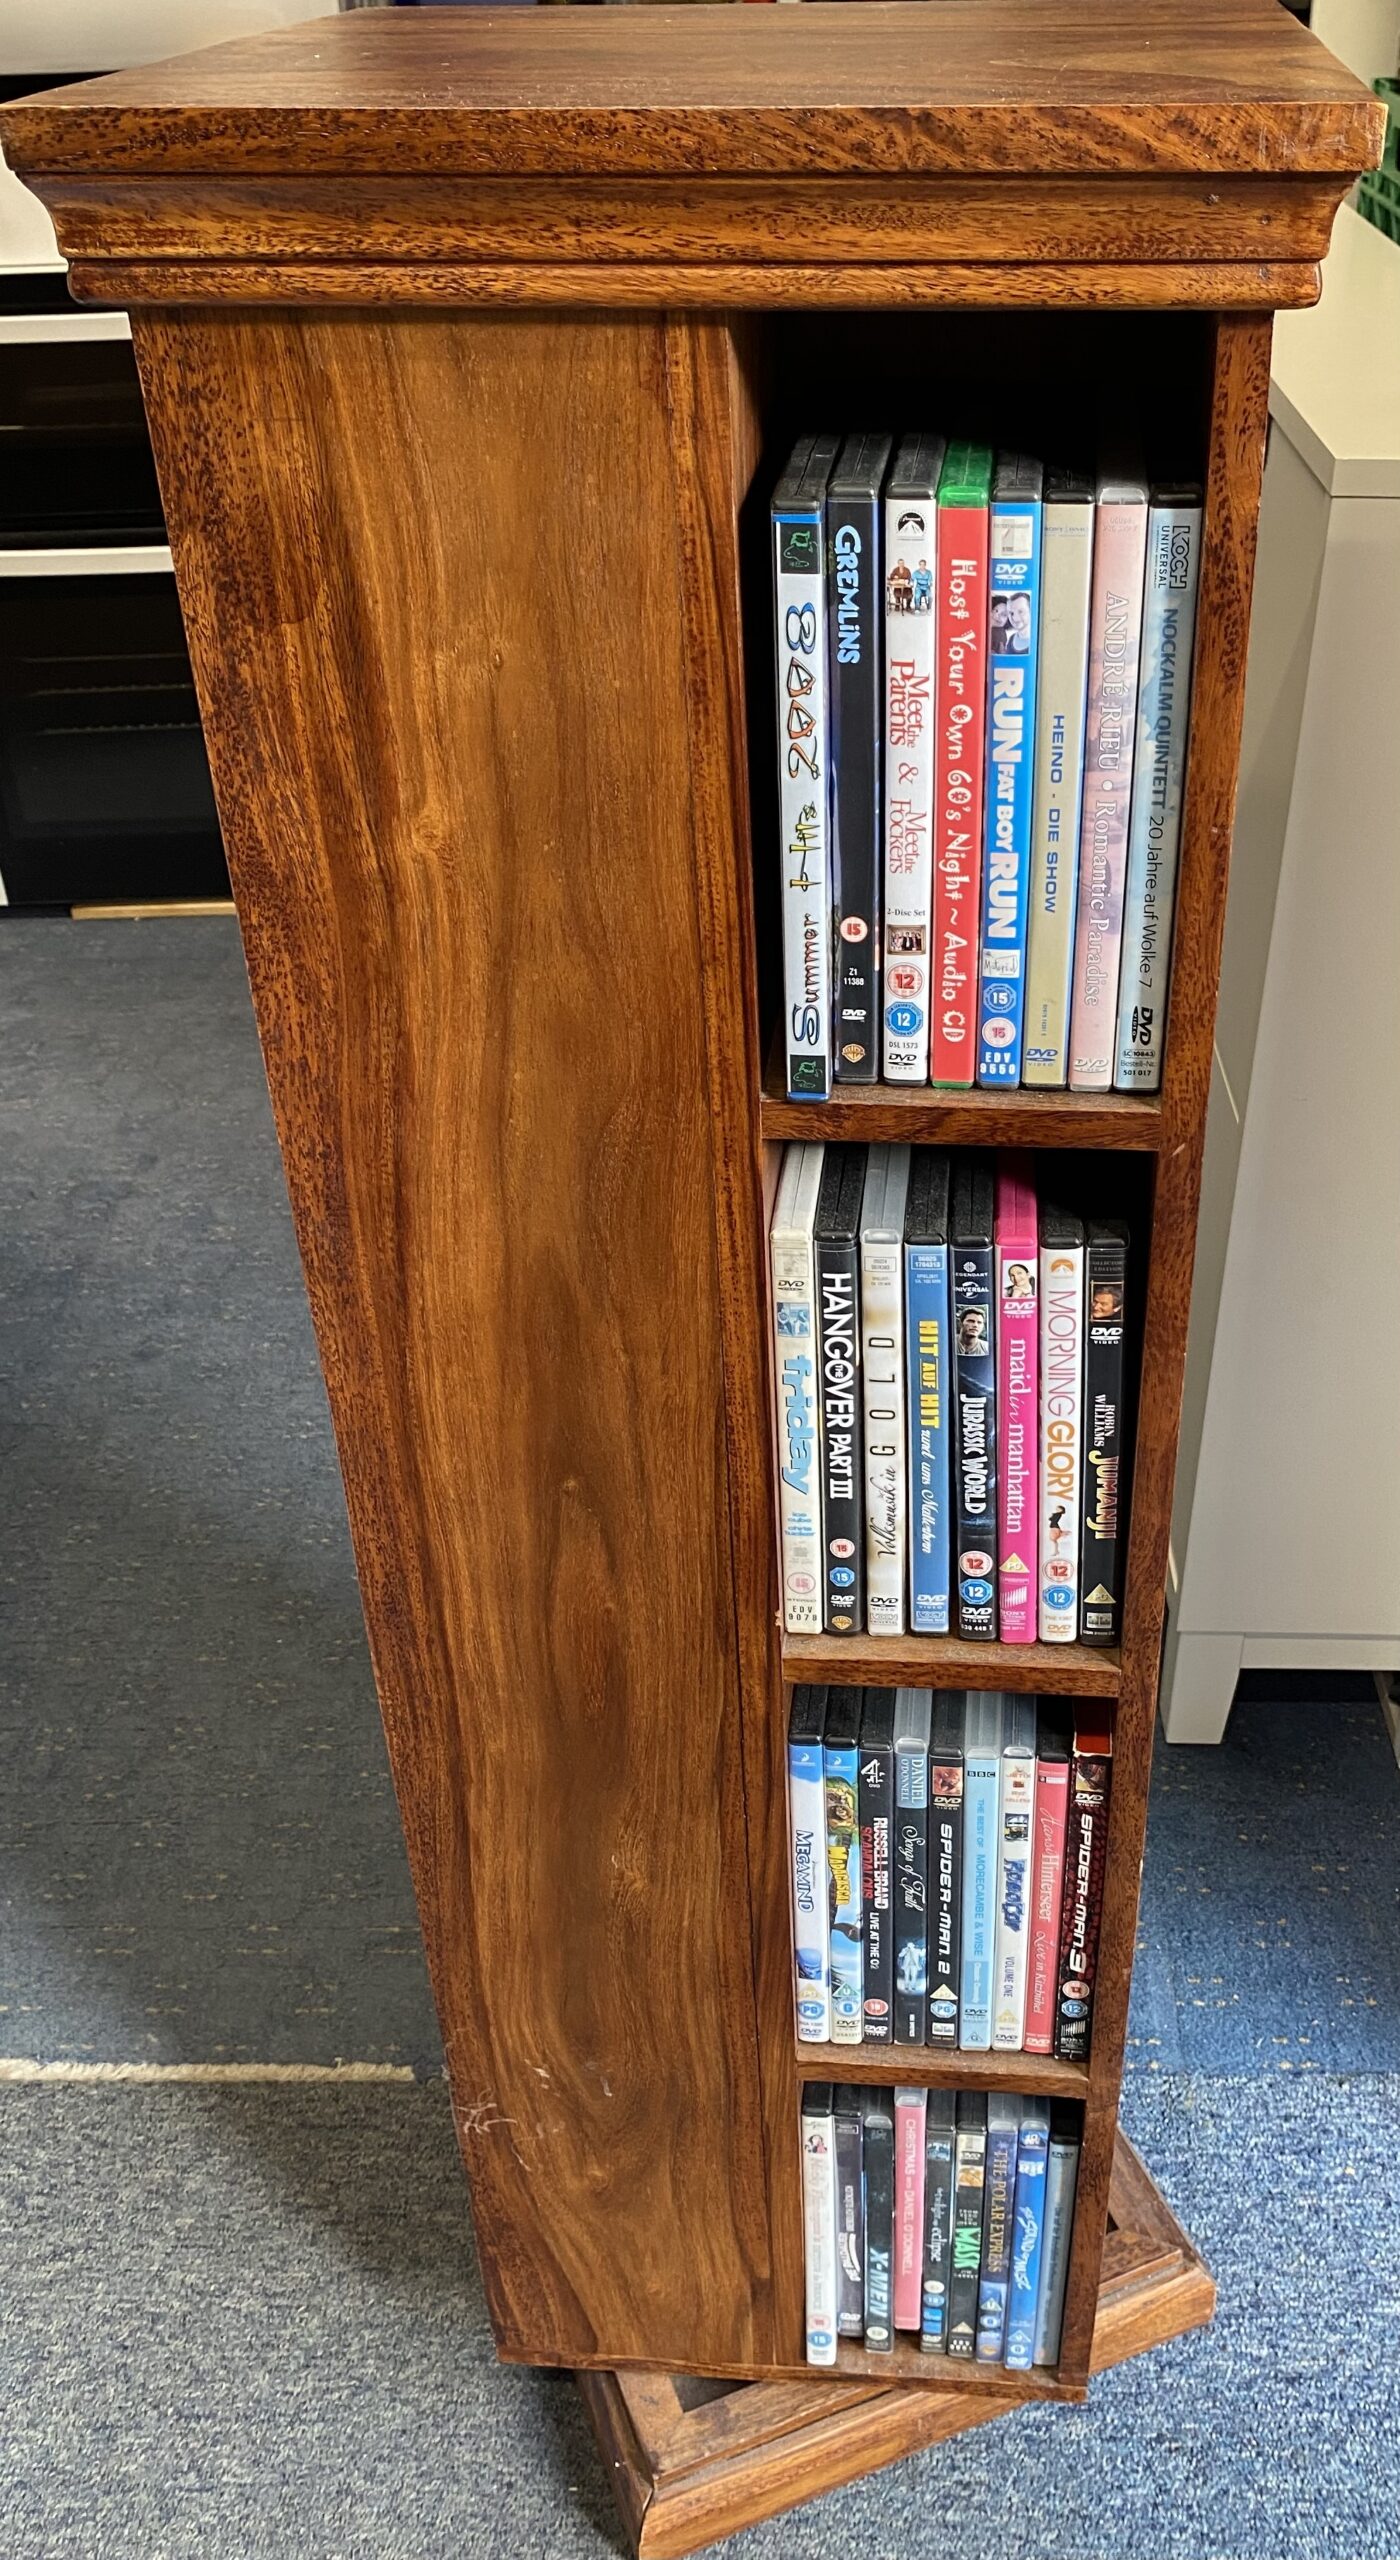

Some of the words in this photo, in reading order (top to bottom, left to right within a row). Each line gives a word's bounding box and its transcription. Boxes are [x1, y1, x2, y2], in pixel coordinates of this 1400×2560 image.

[1158, 526, 1169, 589] UNIVERSAL
[1169, 525, 1191, 590] KOCH
[949, 559, 978, 620] Host
[948, 629, 977, 697] Your
[1103, 592, 1129, 697] ANDRÉ
[1159, 608, 1179, 711] NOCKALM
[786, 602, 821, 780] 2008
[889, 657, 915, 747] Parents
[906, 673, 930, 732] Meet
[946, 703, 974, 760] Own
[992, 667, 1024, 763] RUN
[906, 730, 919, 748] the
[1051, 714, 1064, 784] HEINO
[1098, 702, 1122, 771] RIEU
[898, 762, 919, 784] &
[1152, 716, 1173, 809] QUINTETT
[946, 769, 972, 822] 60's
[997, 764, 1017, 803] FAT
[904, 812, 927, 860] Meet
[996, 805, 1015, 853] BOY
[1047, 808, 1060, 843] DIE
[1148, 816, 1165, 839] 20
[904, 858, 917, 874] the
[939, 829, 973, 901] Night
[1089, 800, 1116, 911] Romantic
[1144, 841, 1163, 891] Jahre
[988, 852, 1019, 939] RUN
[1044, 852, 1058, 913] SHOW
[887, 907, 912, 917] 2-Disc
[914, 908, 926, 917] Set
[1143, 893, 1159, 921] auf
[846, 923, 861, 936] 15
[1139, 921, 1157, 974] Wolke
[792, 912, 820, 1046] Summer
[895, 973, 915, 989] 12
[941, 931, 968, 1002] Audio
[1083, 918, 1110, 1007] Paradise
[992, 992, 1008, 1005] 15
[1138, 978, 1153, 988] 7
[897, 1012, 911, 1026] 12
[941, 1010, 966, 1043] CD
[1139, 1007, 1154, 1046] DVD
[888, 1053, 917, 1062] DVD
[985, 1052, 1011, 1063] EDV
[1026, 1048, 1058, 1058] DVD
[1004, 1302, 1036, 1310] DVD
[822, 1273, 855, 1428] HANGOVER
[918, 1320, 939, 1357] HIT
[1091, 1327, 1124, 1336] DVD
[835, 1364, 844, 1378] THE
[1010, 1338, 1032, 1396] maid
[1048, 1290, 1077, 1417] MORNING
[919, 1357, 939, 1391] AUF
[781, 1354, 815, 1495] friday
[920, 1393, 940, 1429] HIT
[960, 1393, 987, 1455] JURASSIC
[1093, 1394, 1106, 1447] WILLIAMS
[1105, 1404, 1116, 1437] ROBIN
[829, 1433, 853, 1479] PART
[880, 1466, 897, 1485] in
[920, 1461, 932, 1487] ums
[1047, 1420, 1076, 1502] GLORY
[830, 1479, 854, 1500] III
[961, 1456, 988, 1514] WORLD
[1007, 1422, 1030, 1534] manhattan
[1086, 1449, 1120, 1541] JUMANJI
[869, 1477, 897, 1558] Volksmusik
[836, 1573, 848, 1582] 15
[967, 1558, 984, 1570] 12
[1051, 1564, 1069, 1577] 12
[792, 1605, 813, 1614] EDV
[830, 1594, 856, 1602] DVD
[968, 1586, 984, 1597] 12
[1053, 1592, 1065, 1603] 12
[911, 1758, 924, 1804] DANIEL
[967, 1770, 996, 1778] BBC
[977, 1798, 985, 1814] THE
[977, 1816, 985, 1835] BEST
[873, 1817, 889, 1869] RUSSELL
[898, 1825, 926, 1862] Songs
[976, 1836, 984, 1848] OF
[795, 1829, 815, 1913] MEGAMIND
[861, 1825, 874, 1900] SCANDALOUS
[897, 1864, 924, 1880] of
[1073, 1813, 1093, 1948] SPIDER-MAN
[873, 1870, 889, 1910] BRAND
[900, 1876, 926, 1912] Faith
[938, 1823, 954, 1948] SPIDER-MAN
[975, 1853, 985, 1919] MORECAMBE
[1038, 1853, 1060, 1922] Hinterseer
[869, 1912, 880, 1930] LIVE
[870, 1930, 880, 1940] AT
[870, 1941, 880, 1957] THE
[974, 1931, 984, 1956] WISE
[1069, 1948, 1087, 1974] 3
[938, 1961, 950, 1975] 2
[1004, 1956, 1015, 1982] VOLUME
[1003, 1984, 1014, 1998] ONE
[905, 2118, 916, 2175] CHRISTMAS
[993, 2150, 1008, 2177] THE
[903, 2189, 915, 2224] DANIEL
[990, 2180, 1007, 2221] POLAR
[925, 2227, 947, 2262] eclipse
[954, 2228, 981, 2270] MASK
[987, 2223, 1005, 2273] EXPRESS
[1016, 2215, 1038, 2253] SOUND
